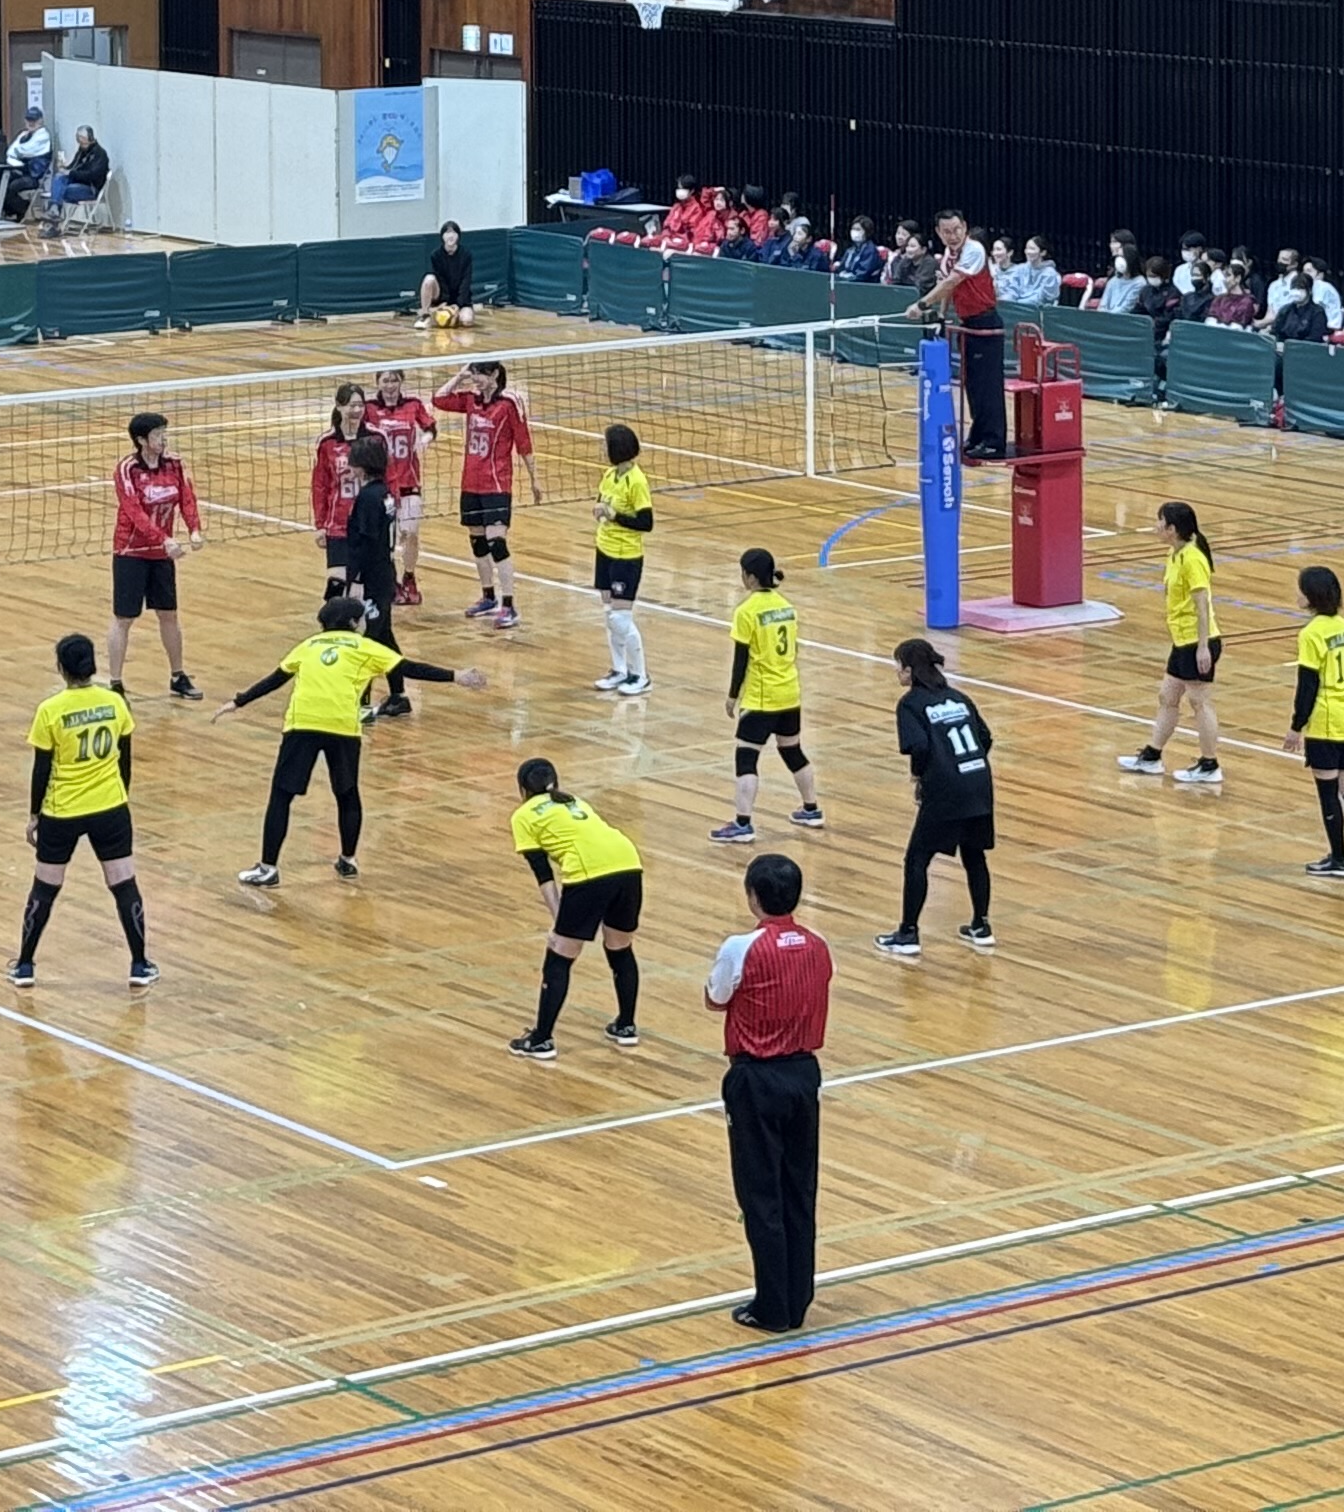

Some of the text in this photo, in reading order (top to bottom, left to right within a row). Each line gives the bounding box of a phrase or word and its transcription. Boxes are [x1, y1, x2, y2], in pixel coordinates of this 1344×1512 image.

[320, 645, 339, 666] 6
[775, 625, 788, 656] 3
[74, 725, 113, 763] 10
[947, 723, 978, 755] 11
